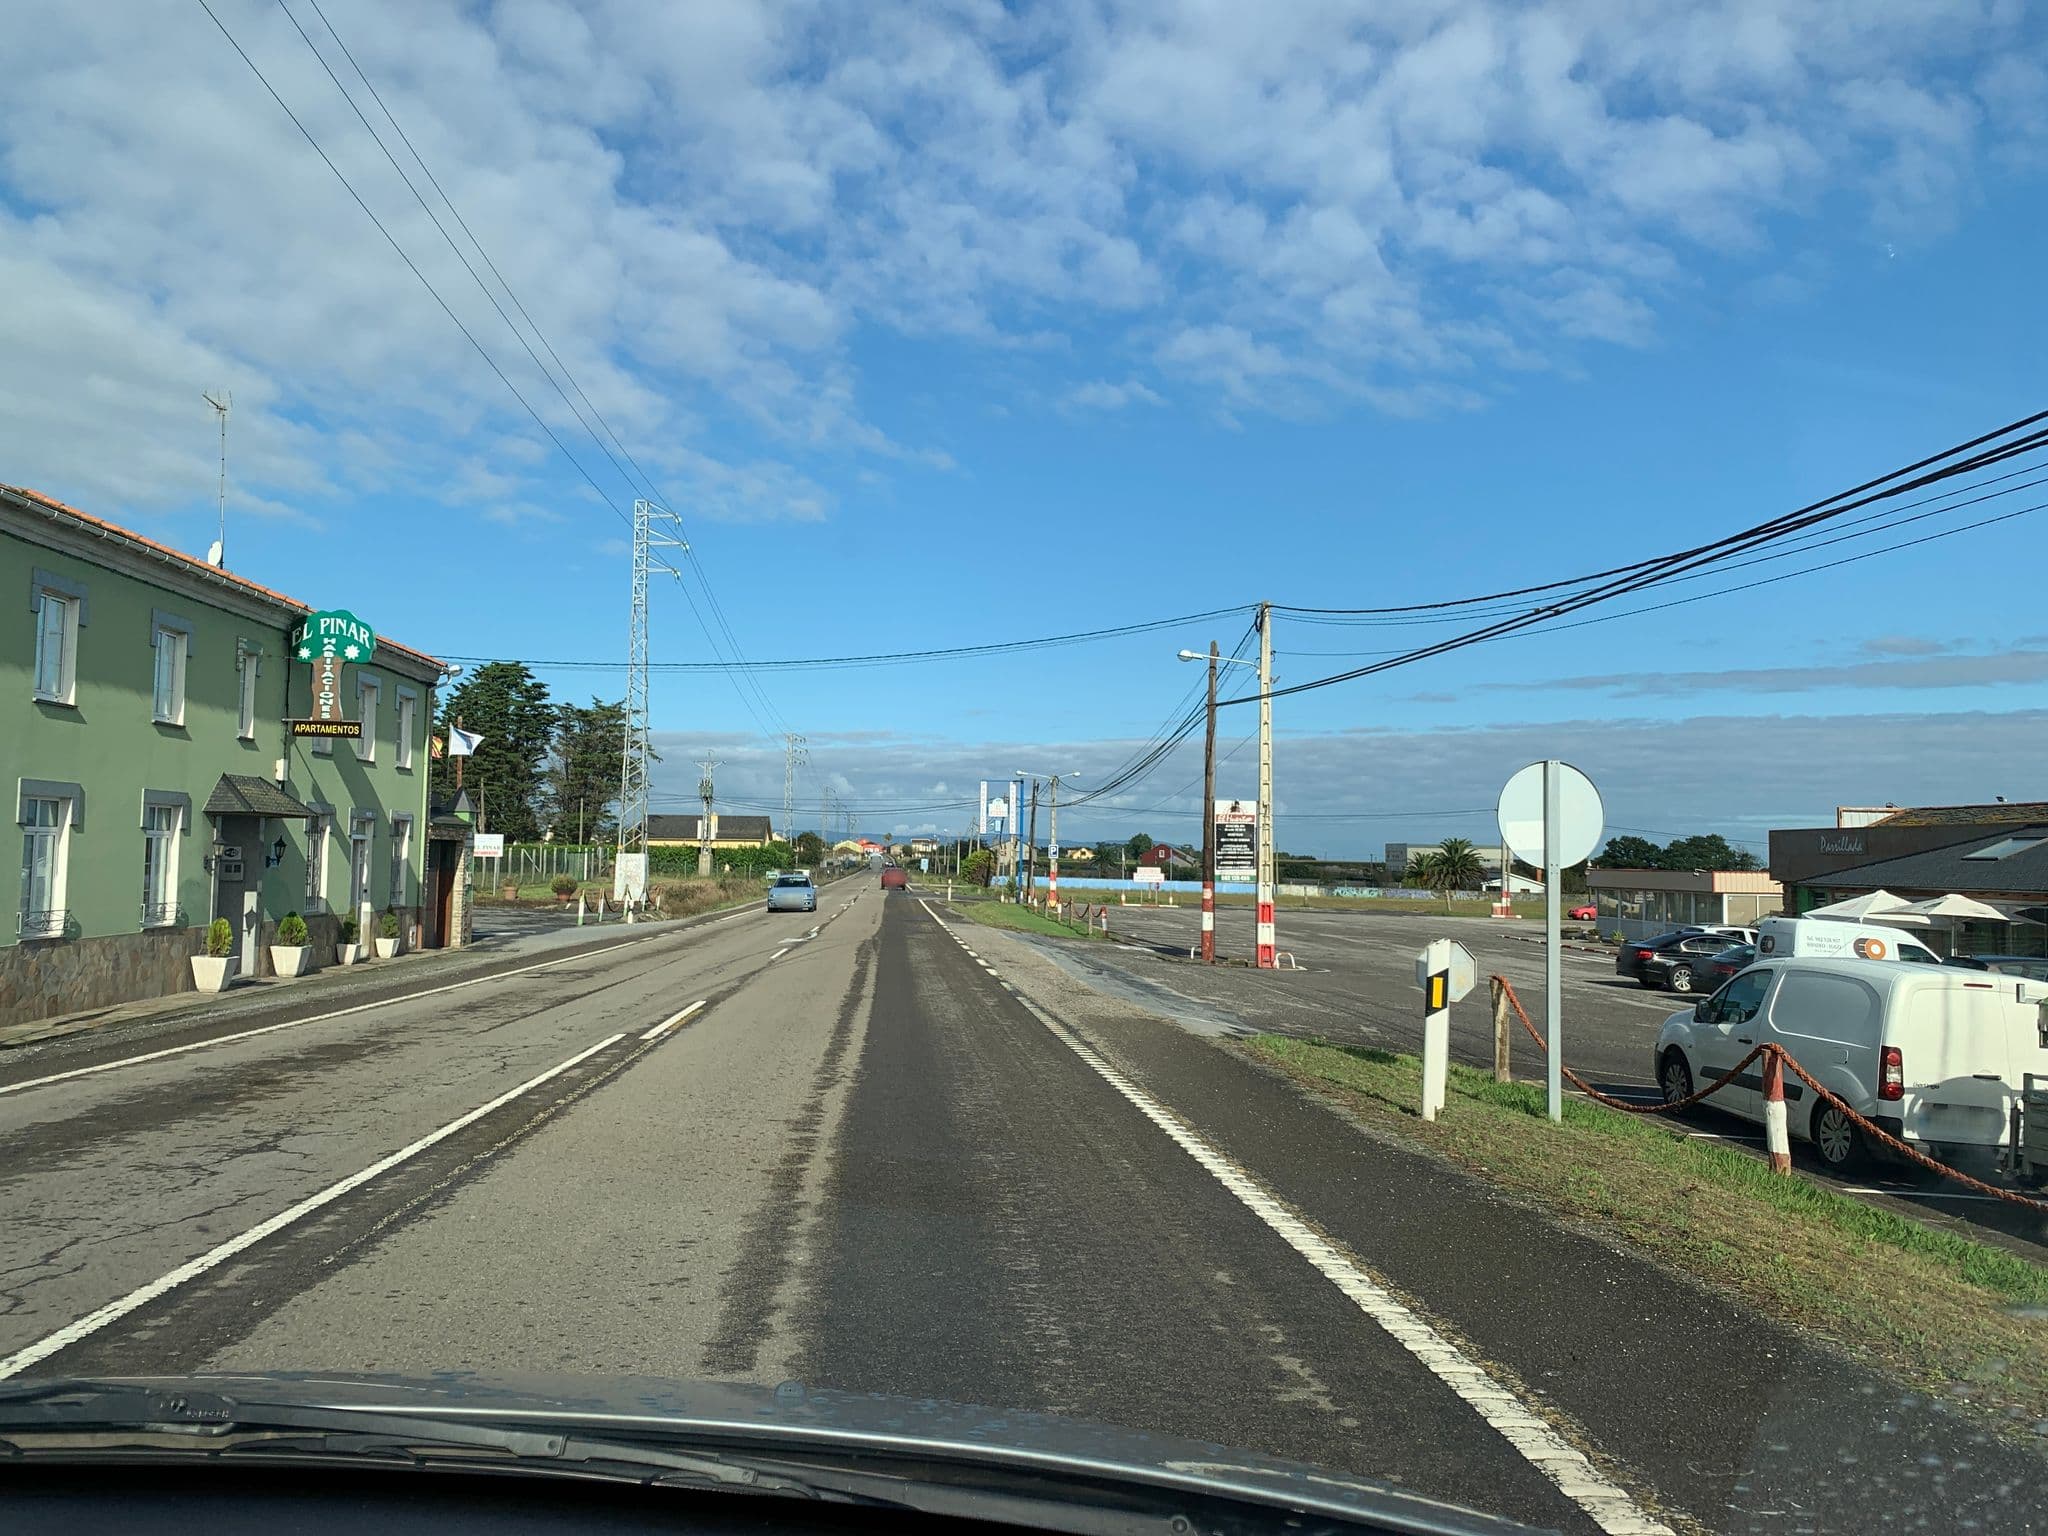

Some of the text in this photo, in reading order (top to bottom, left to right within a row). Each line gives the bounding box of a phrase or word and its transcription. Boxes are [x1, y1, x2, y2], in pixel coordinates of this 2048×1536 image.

[291, 617, 371, 649] EL PINAR
[319, 638, 336, 720] HABITACIONES
[294, 723, 360, 735] APARTAMENTOS
